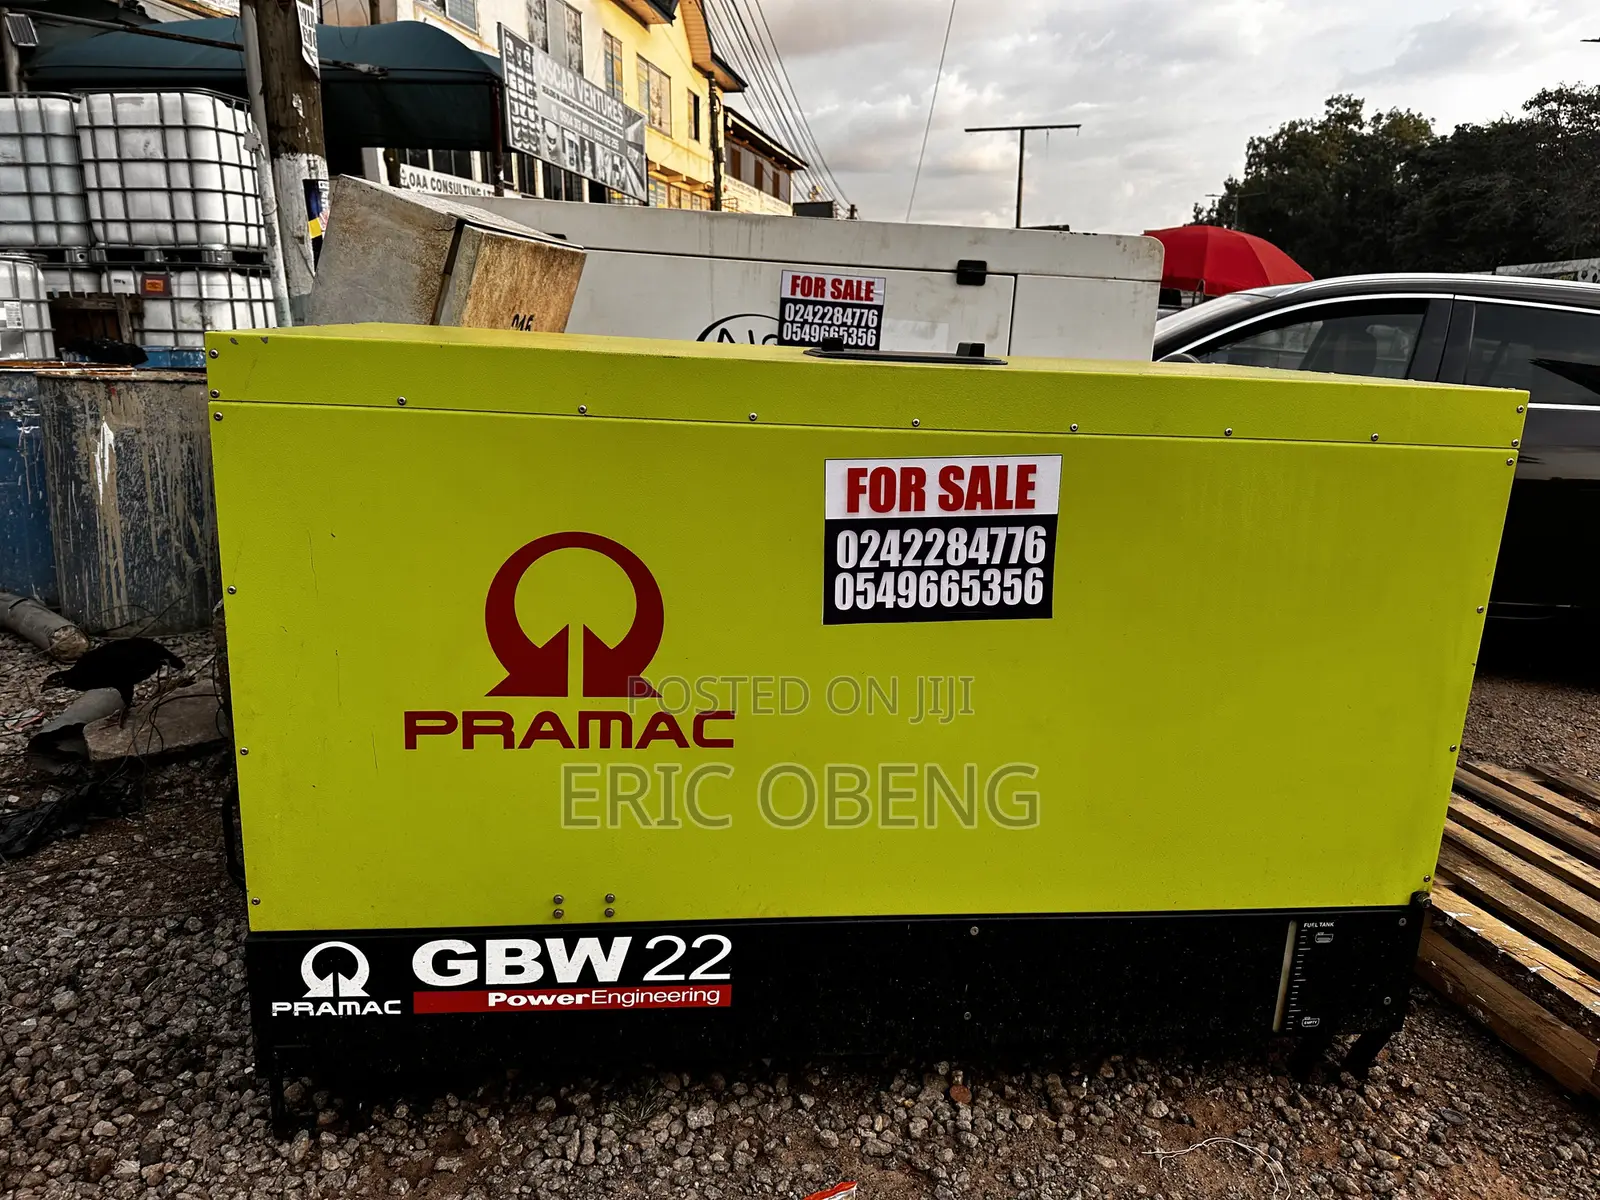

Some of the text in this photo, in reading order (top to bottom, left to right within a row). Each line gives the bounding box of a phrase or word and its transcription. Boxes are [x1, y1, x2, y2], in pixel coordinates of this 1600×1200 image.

[538, 55, 577, 99] OSCAR
[576, 77, 624, 126] VENTURES
[409, 172, 429, 190] OAA
[430, 177, 482, 196] CONSULTING
[790, 275, 875, 302] FOR SALE
[784, 302, 879, 328] 0242284776
[846, 464, 1037, 513] FOR SALE
[836, 525, 1047, 569] 0242284776
[834, 567, 1044, 610] 0549665356
[404, 710, 735, 750] PRAMAC
[411, 933, 733, 987] GBW 22
[271, 1000, 402, 1017] PRAMAC
